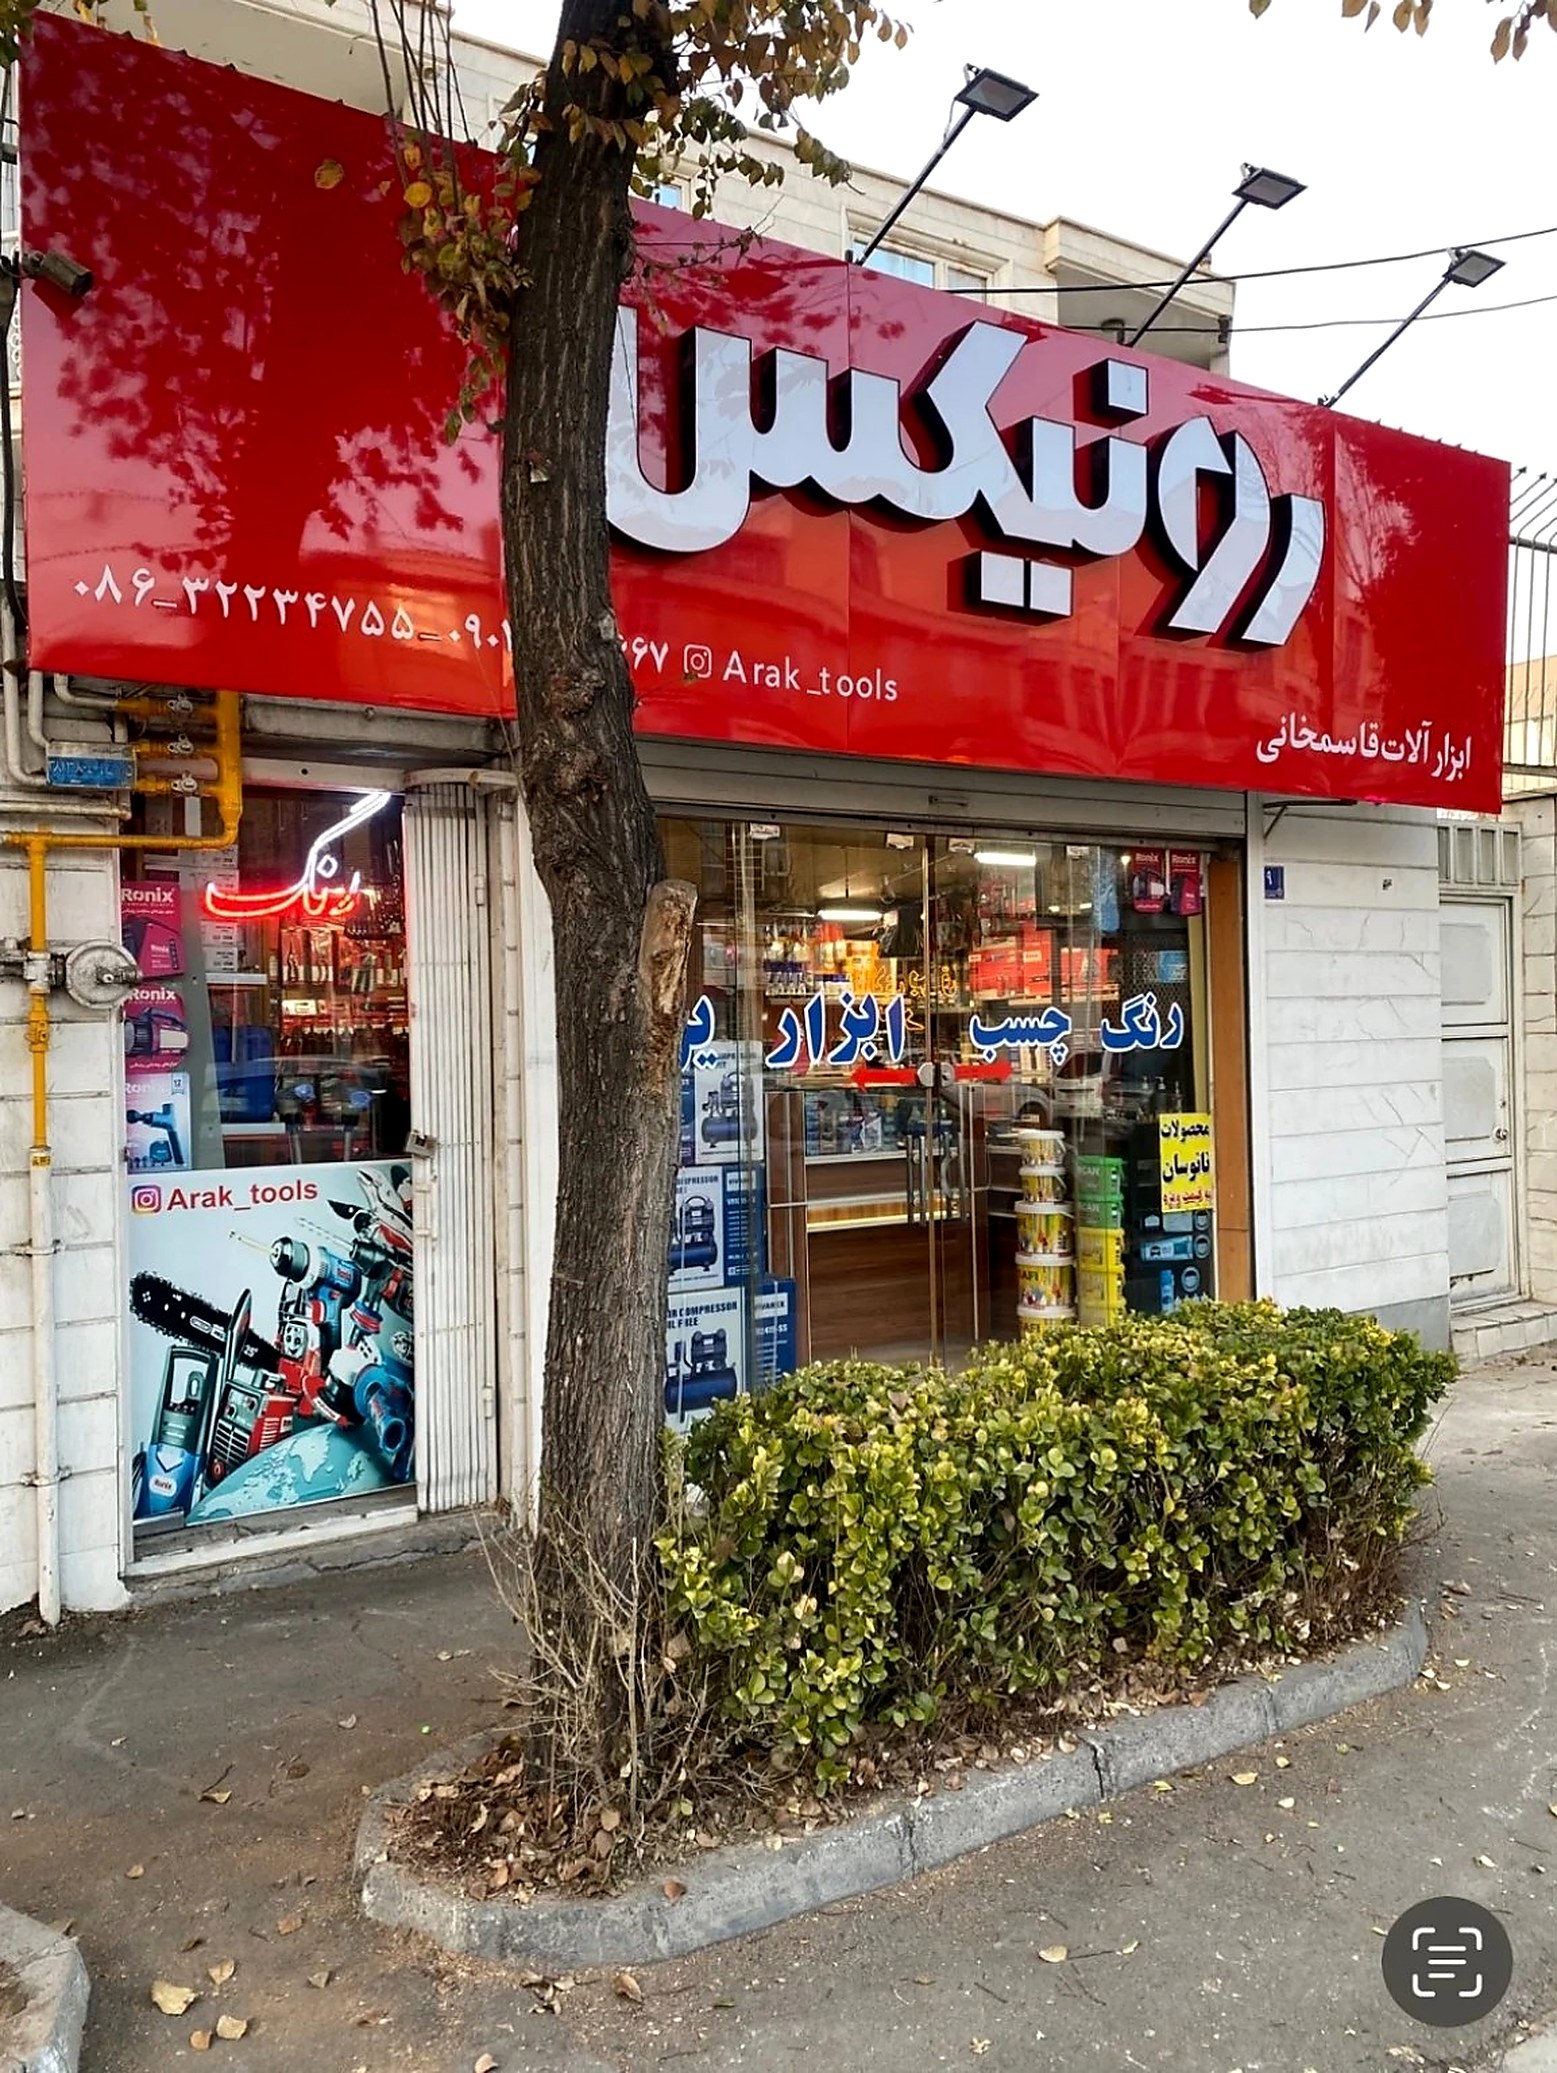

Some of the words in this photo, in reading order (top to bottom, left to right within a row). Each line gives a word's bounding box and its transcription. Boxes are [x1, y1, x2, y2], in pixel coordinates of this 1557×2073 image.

[605, 304, 1326, 648] رونیکس
[722, 650, 898, 701] Arak_tools
[1256, 711, 1380, 763] قاسمخانی
[1380, 719, 1433, 764] آلات
[1430, 731, 1473, 782] ابزار
[121, 886, 174, 903] Ronix
[764, 988, 906, 1069] ابزار
[968, 1005, 1073, 1066] چسب
[1100, 991, 1185, 1053] رنگ
[1161, 1119, 1210, 1142] محصولات
[167, 1179, 319, 1212] Arak_tools
